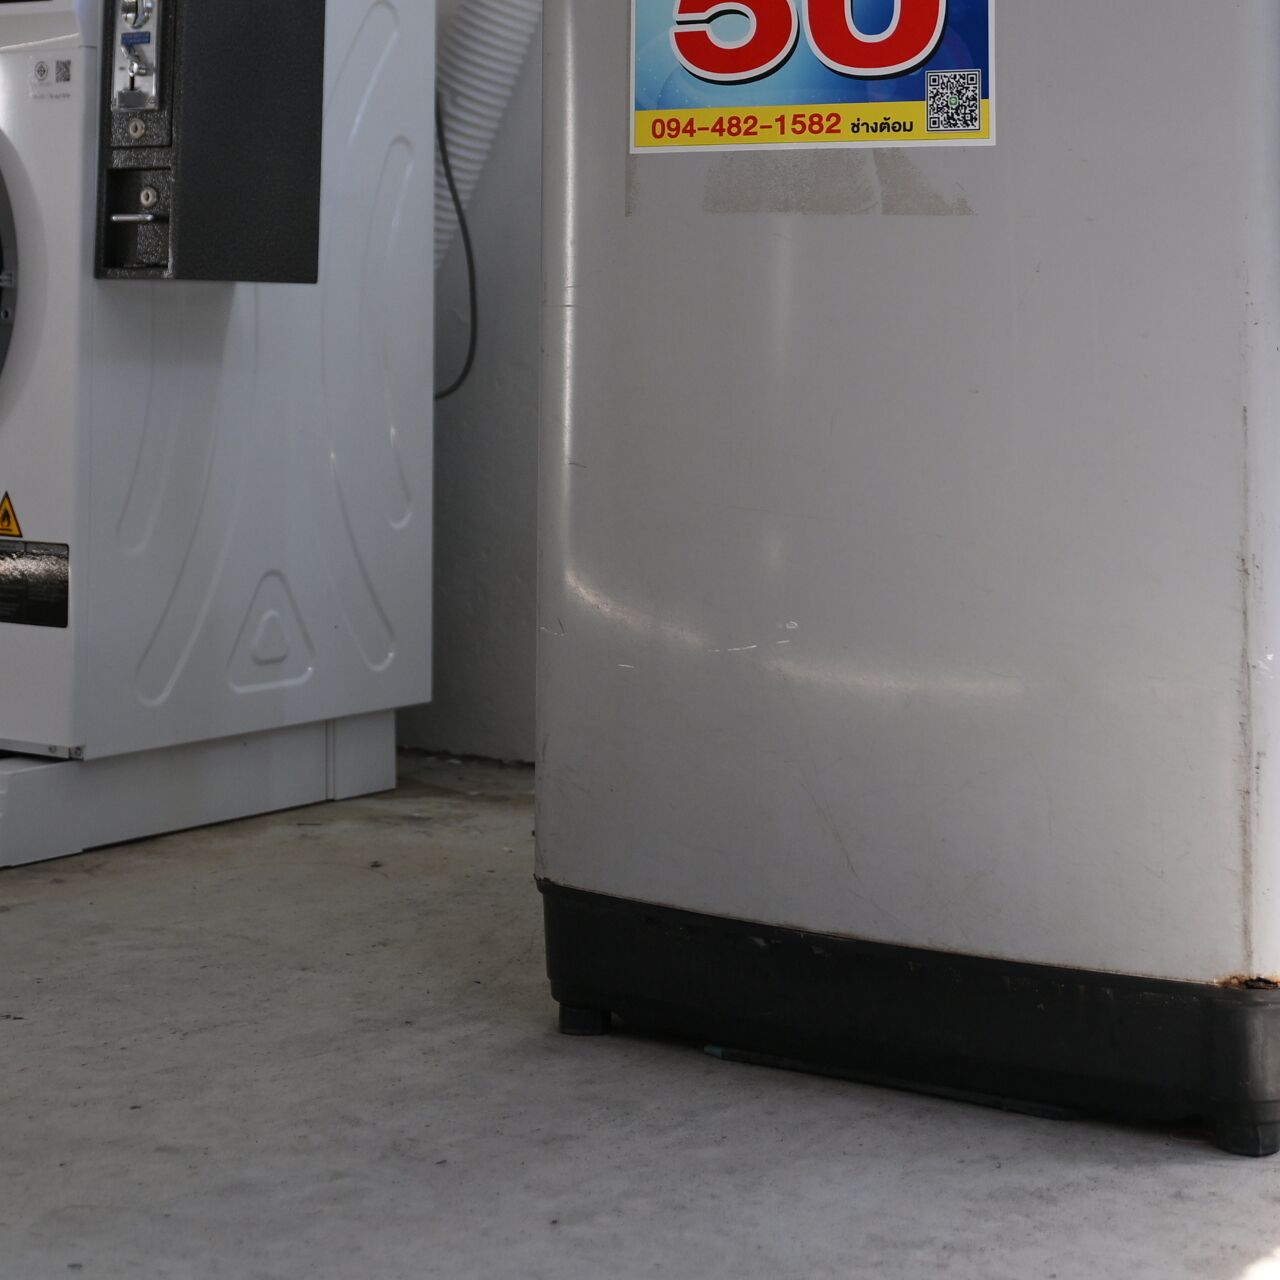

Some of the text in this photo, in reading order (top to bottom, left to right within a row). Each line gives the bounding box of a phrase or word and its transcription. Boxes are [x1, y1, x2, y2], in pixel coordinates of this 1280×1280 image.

[651, 113, 914, 139] 094-482-1582 ช่างต้อม
